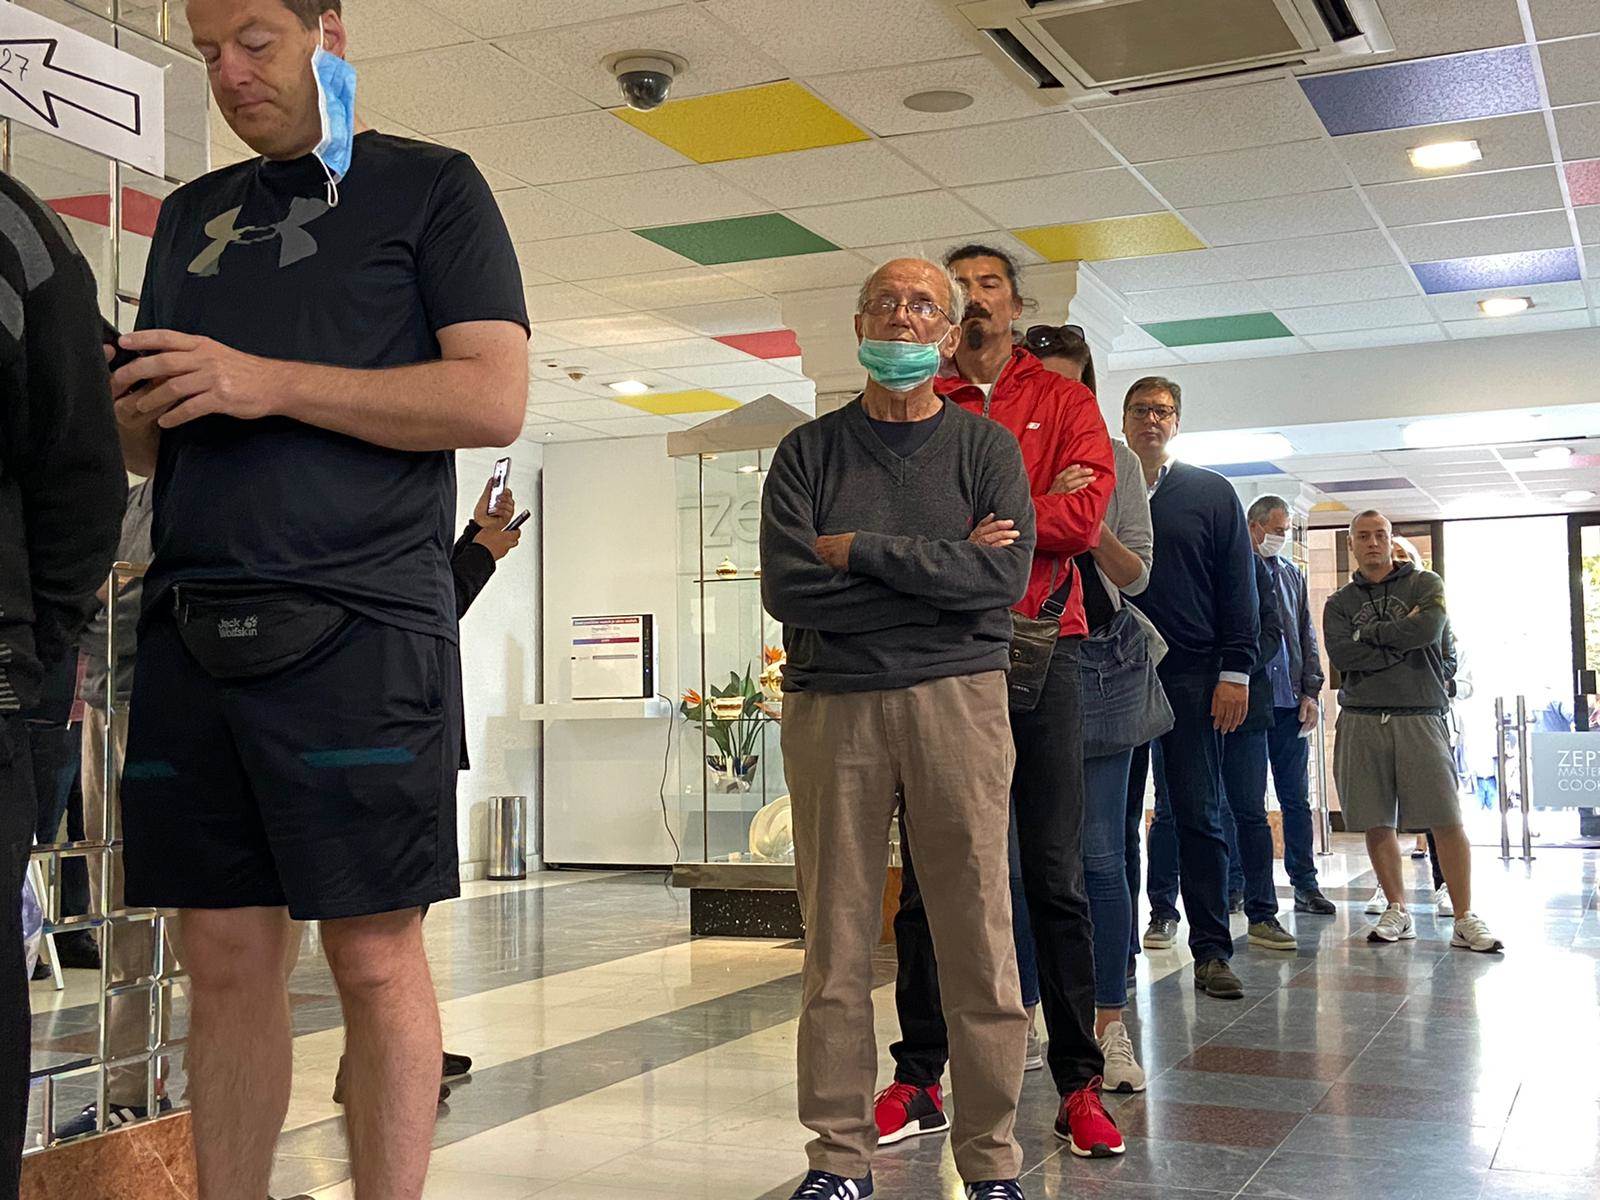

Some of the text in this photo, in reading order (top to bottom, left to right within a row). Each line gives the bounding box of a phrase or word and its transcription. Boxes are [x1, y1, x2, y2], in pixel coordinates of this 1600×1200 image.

[0, 48, 29, 81] 27
[218, 618, 241, 629] Jack
[1557, 750, 1600, 767] ZEP
